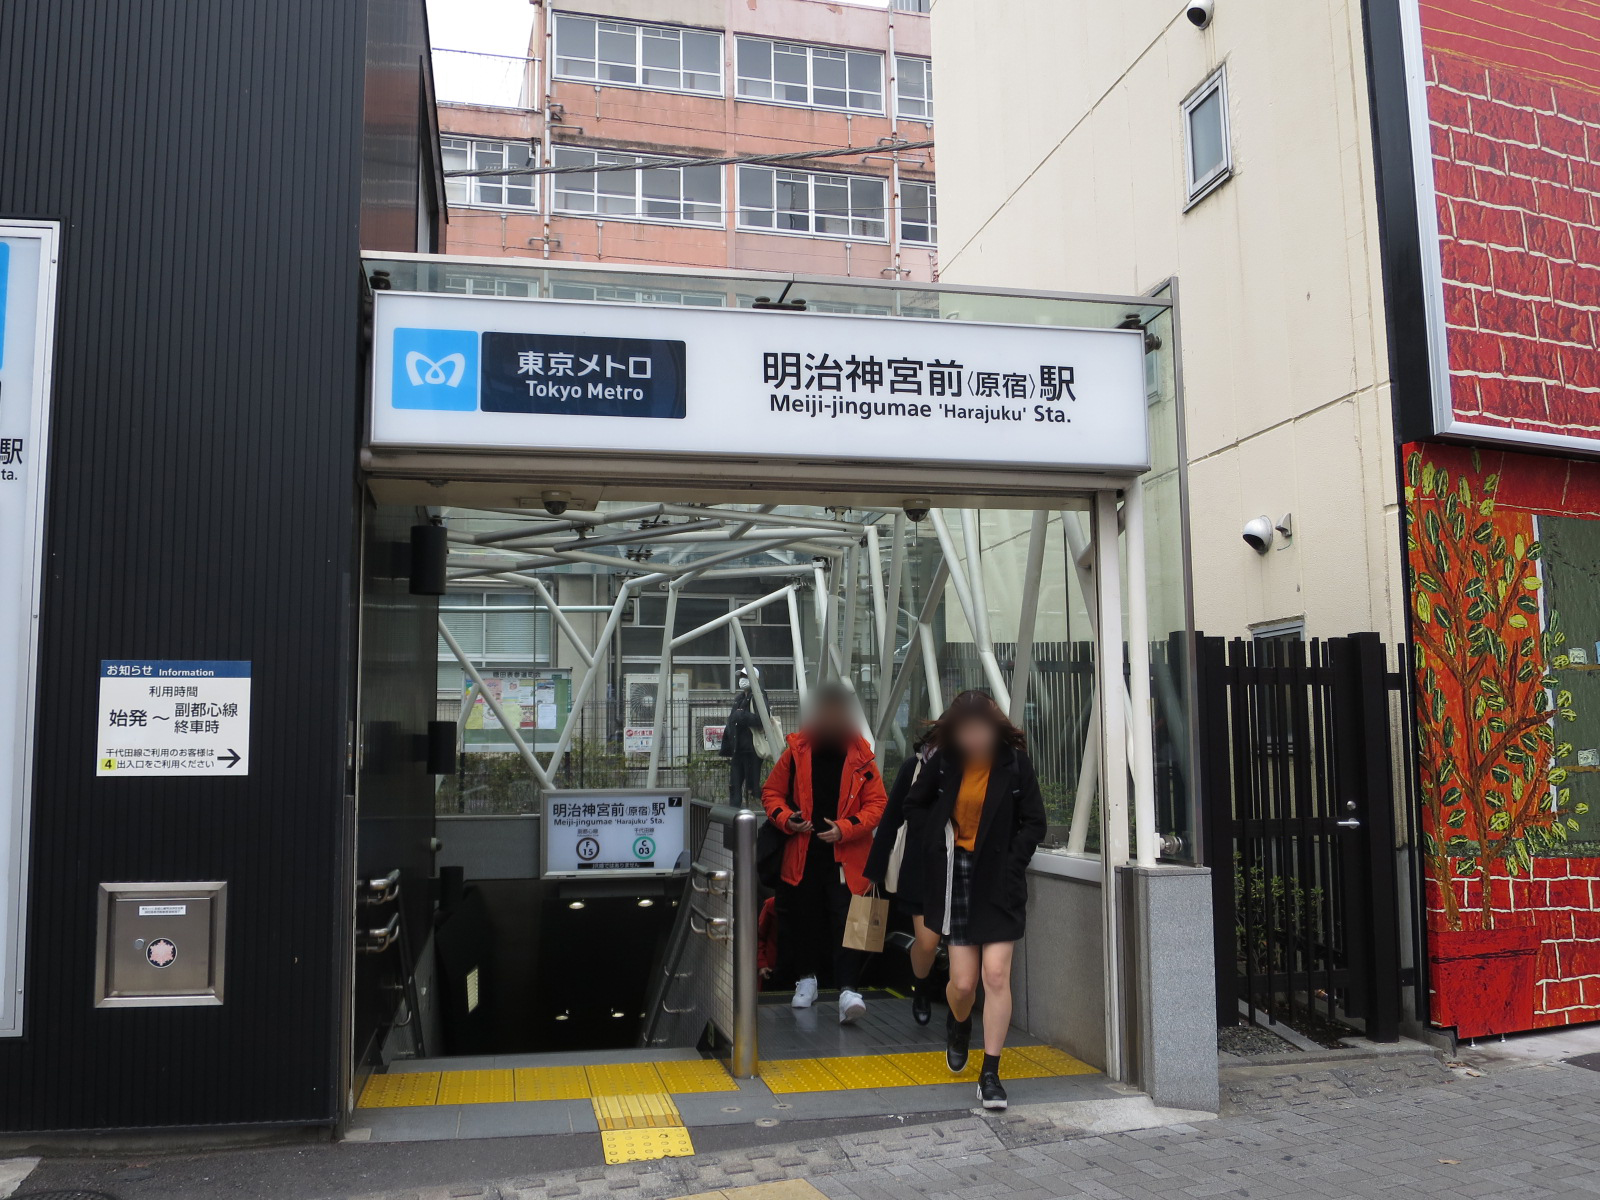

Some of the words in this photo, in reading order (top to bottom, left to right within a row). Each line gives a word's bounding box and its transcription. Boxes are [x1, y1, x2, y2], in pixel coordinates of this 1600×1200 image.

[517, 351, 652, 381] 東京メトロ
[525, 380, 582, 401] Tokyo
[587, 383, 644, 400] Metro
[770, 394, 933, 420] Meiji-jingumae
[938, 404, 1027, 424] 'Harajuku'
[1034, 405, 1072, 423] Sta.
[106, 665, 153, 676] お知らせ
[158, 669, 215, 677] Information
[149, 686, 198, 698] 利用時間
[174, 702, 238, 718] 副都心線
[174, 720, 220, 734] 終車時
[106, 748, 215, 758] 千代田線ご利用のお客様は
[104, 760, 112, 769] 4
[117, 760, 215, 769] 出入口をご利用ください
[672, 798, 678, 806] 7
[553, 818, 613, 827] Meiji-jingumae
[583, 848, 594, 856] 15
[638, 847, 650, 855] 03
